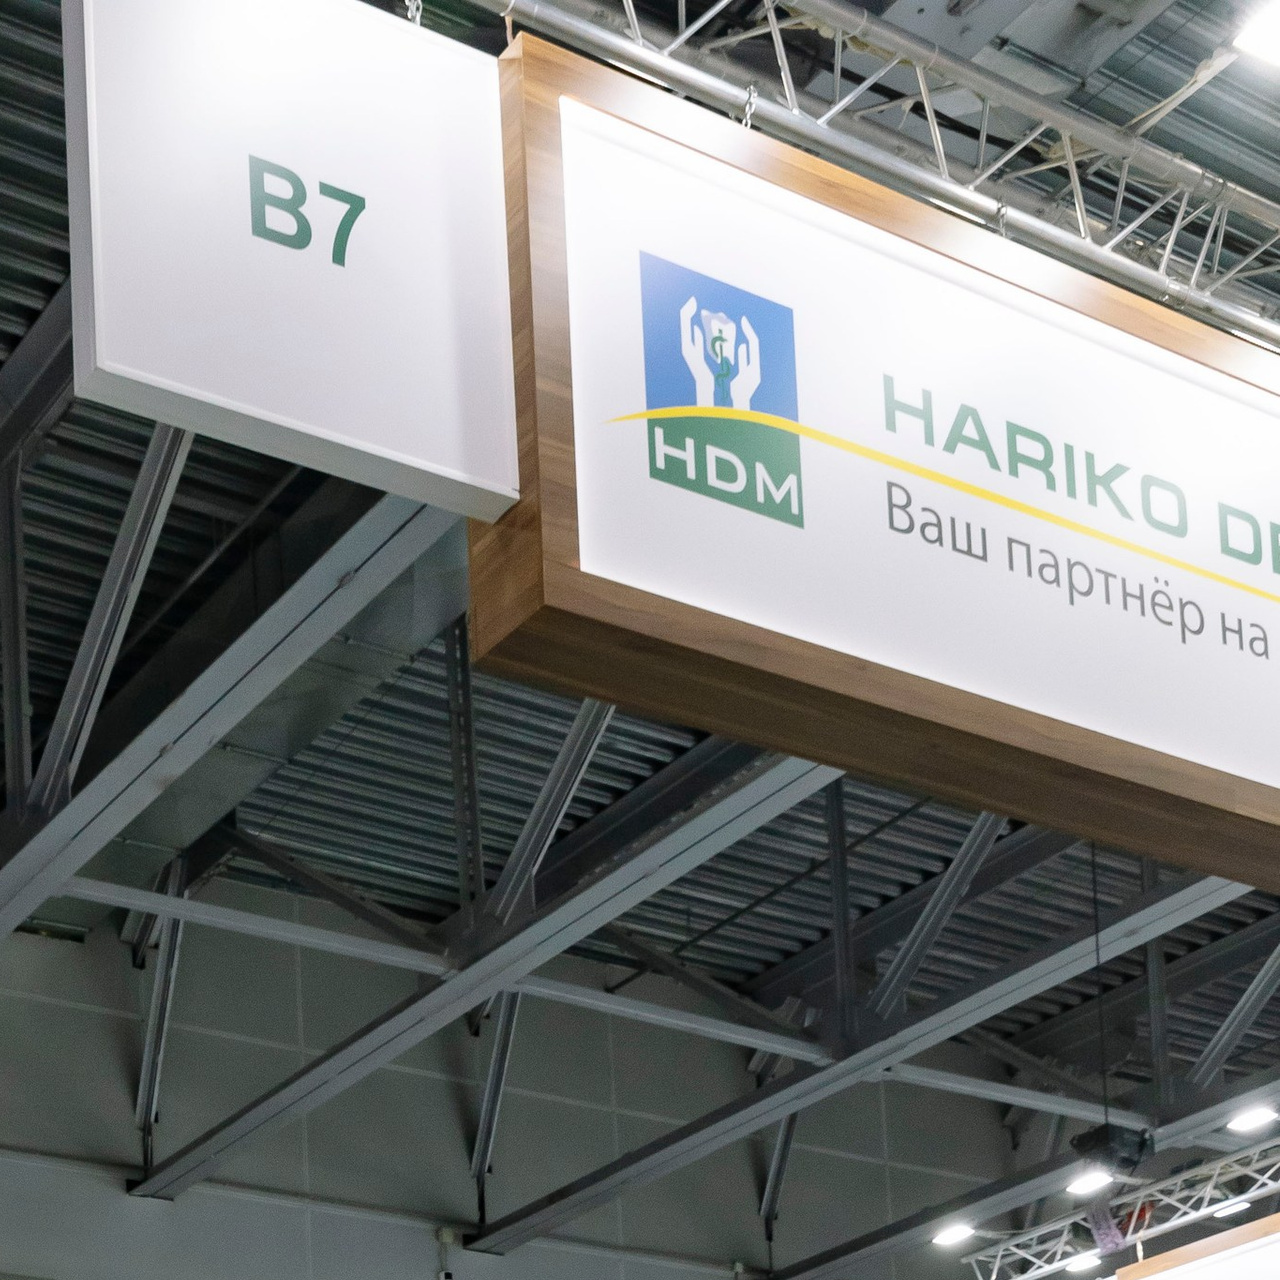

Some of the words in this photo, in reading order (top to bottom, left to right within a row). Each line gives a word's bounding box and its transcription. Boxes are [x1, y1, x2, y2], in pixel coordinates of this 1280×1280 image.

[249, 154, 366, 267] B7
[654, 426, 800, 515] HDM
[883, 372, 1189, 539] HARIKO
[886, 480, 988, 563] Ваш
[1007, 536, 1206, 644] партнёр
[1220, 612, 1270, 660] на
